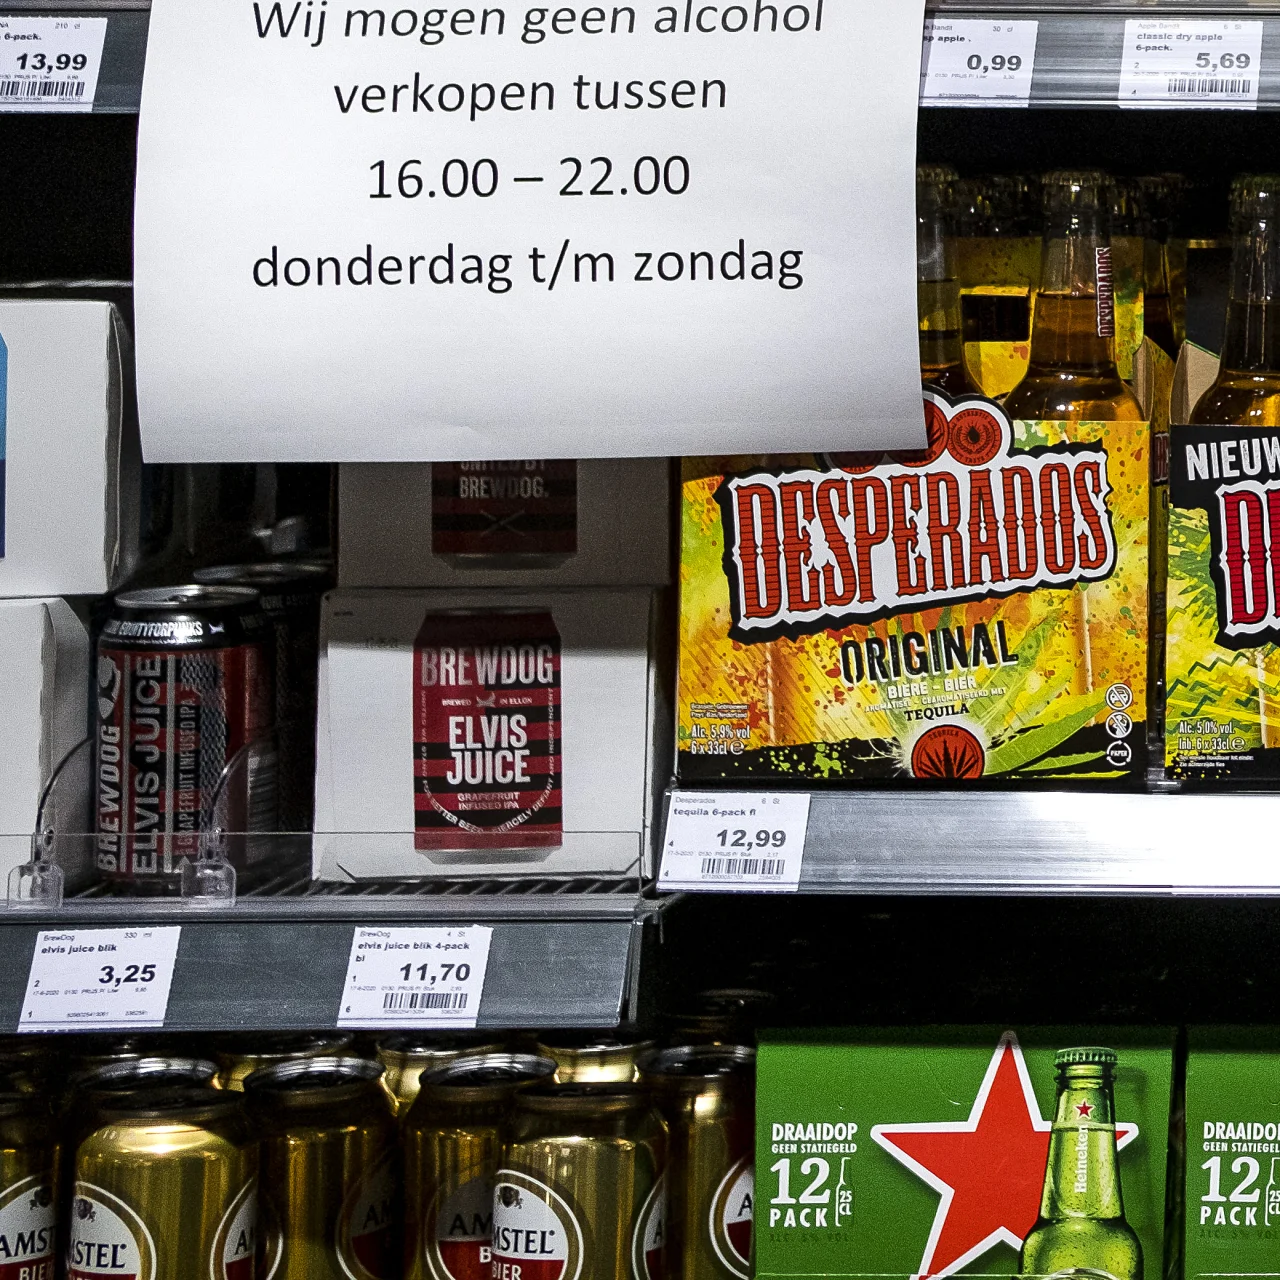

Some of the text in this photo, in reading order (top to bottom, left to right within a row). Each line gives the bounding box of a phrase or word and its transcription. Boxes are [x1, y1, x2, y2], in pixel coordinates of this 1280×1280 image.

[253, 2, 327, 47] Wij
[344, 11, 506, 46] mogen
[522, 9, 636, 44] geen
[1137, 32, 1223, 43] classic dry apple
[17, 53, 87, 73] 13,99
[967, 53, 1021, 73] 0,99
[1196, 52, 1250, 73] 5,69
[334, 72, 728, 120] verkopen tussen
[368, 155, 690, 200] 16.00 22.00
[252, 239, 804, 292] donderdag t/m zondag
[735, 460, 1110, 619] DESPERADOS
[840, 620, 1018, 684] ORIGINAL
[421, 646, 555, 687] BREWDOG
[904, 703, 969, 722] TEQUILA
[448, 715, 528, 749] ELVIS
[446, 749, 530, 786] JUICE
[717, 829, 786, 851] 12,99
[99, 964, 156, 987] 3,25
[398, 963, 471, 984] 11,70
[772, 1123, 857, 1141] DRAAIDOP
[772, 1142, 857, 1153] GEEN STATIEGELD
[1074, 1128, 1089, 1193] Heineken
[770, 1158, 831, 1205] 12
[770, 1207, 829, 1227] PACK
